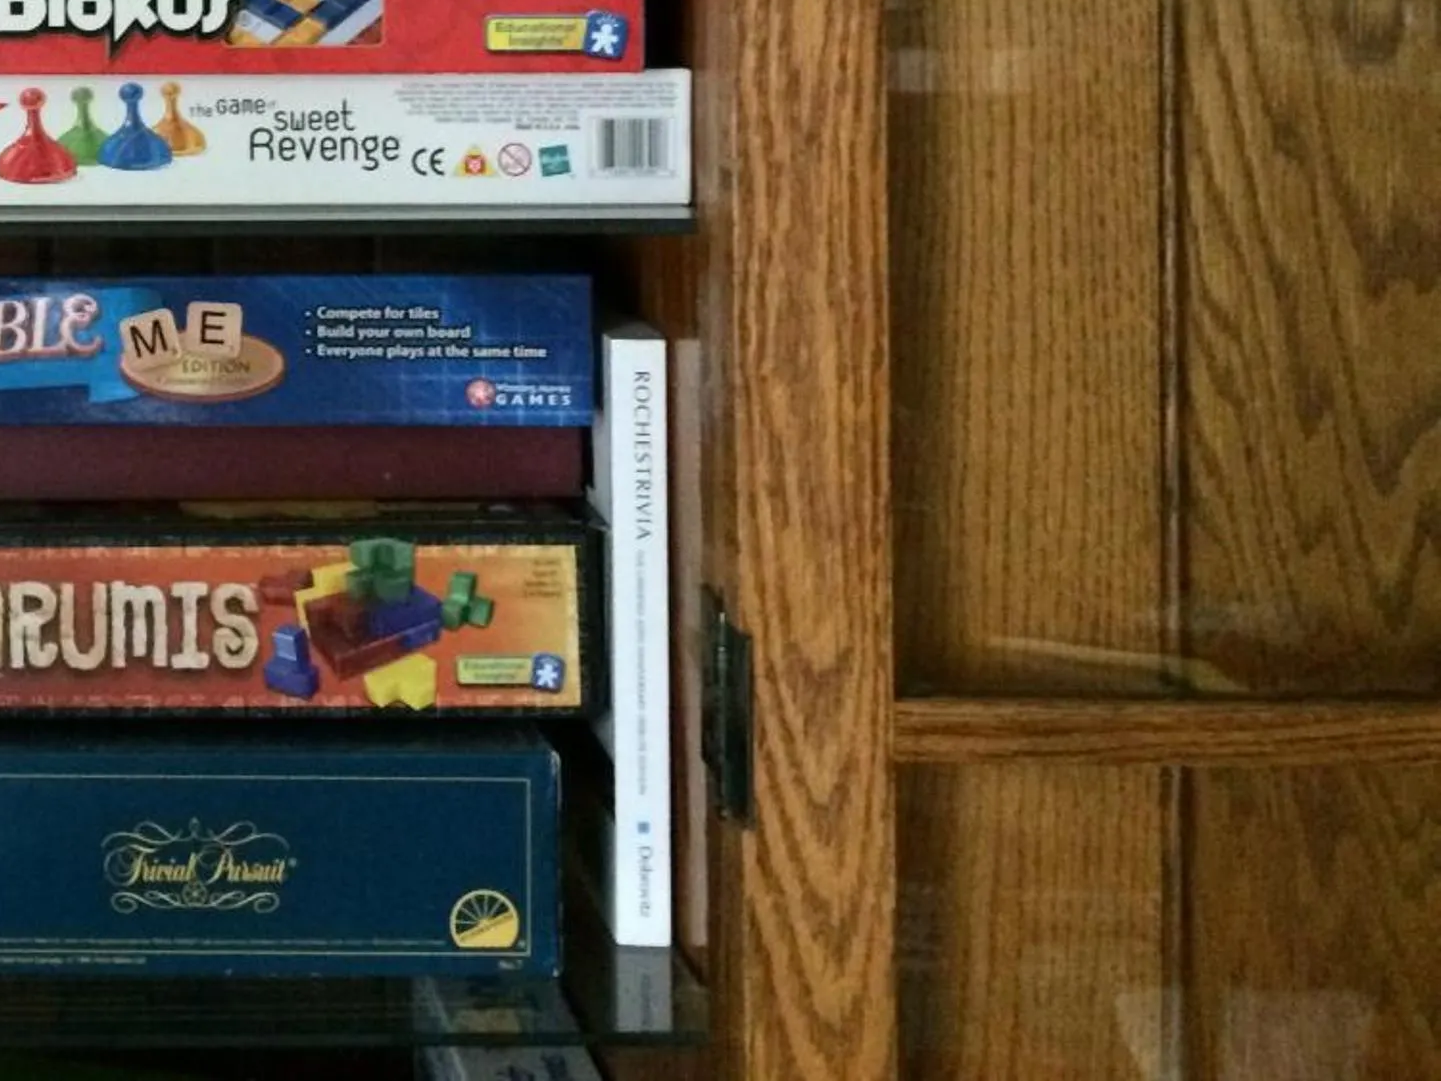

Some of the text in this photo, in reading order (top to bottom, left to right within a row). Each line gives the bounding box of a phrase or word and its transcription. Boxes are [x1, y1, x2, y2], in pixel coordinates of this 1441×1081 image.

[248, 126, 401, 171] Revenge
[316, 305, 440, 323] Compete for tiles
[316, 324, 472, 341] Build your own board
[316, 344, 548, 361] Everyone plays at the same time
[180, 358, 252, 376] EDITION
[494, 393, 573, 406] GAMES
[633, 370, 654, 541] ROCHESTRIVIA
[6, 579, 260, 671] RUMIS
[104, 842, 287, 888] Trivial Pursuit
